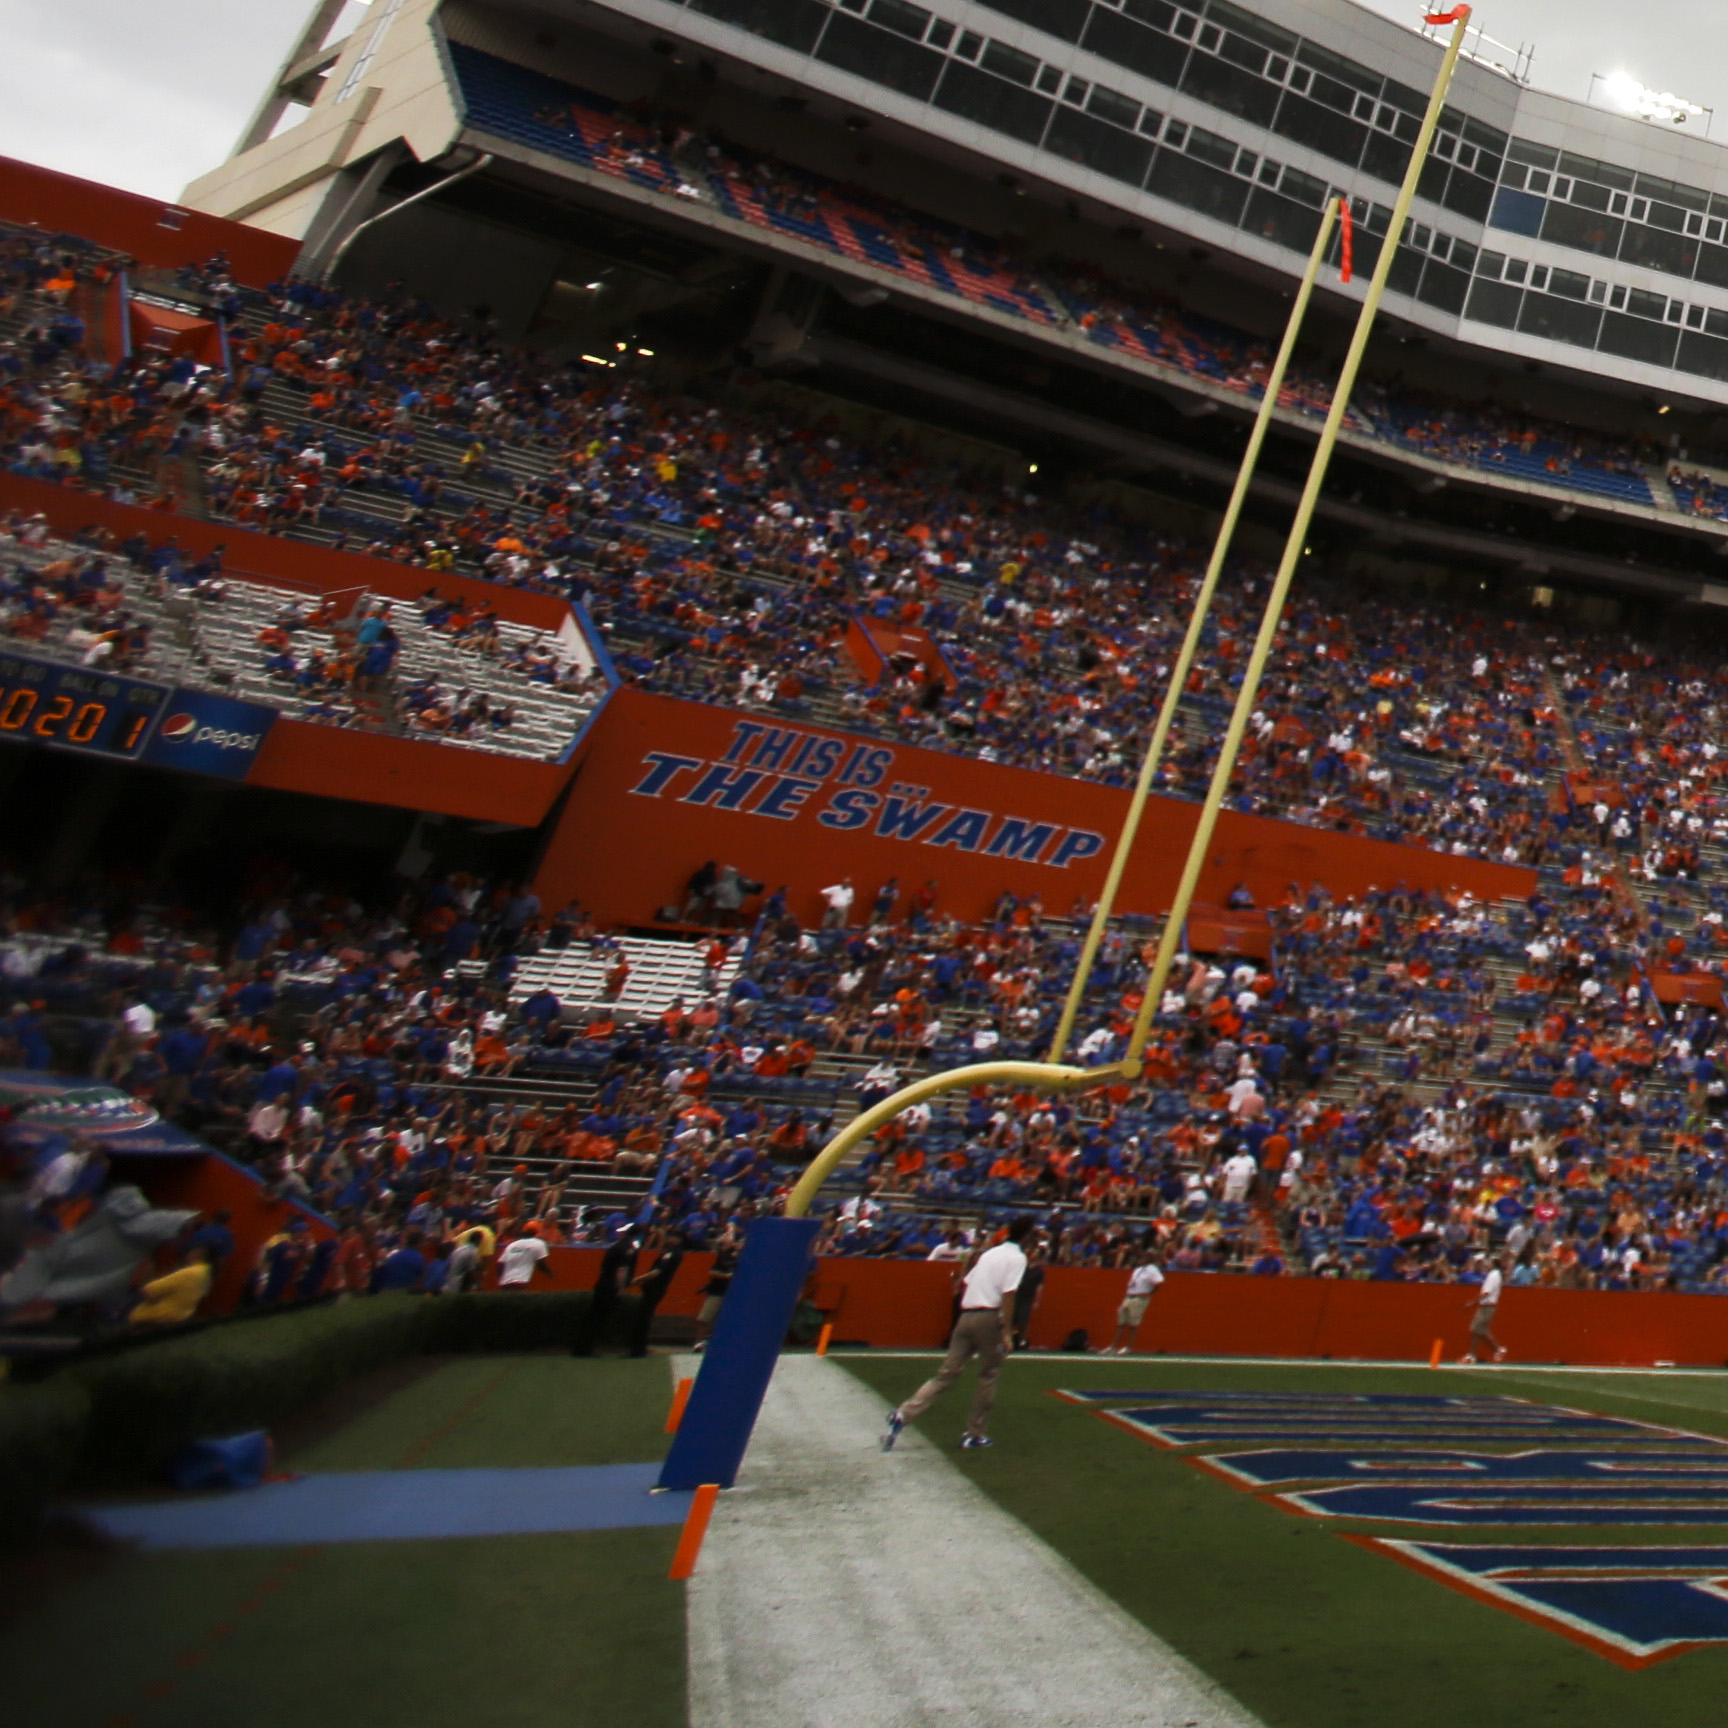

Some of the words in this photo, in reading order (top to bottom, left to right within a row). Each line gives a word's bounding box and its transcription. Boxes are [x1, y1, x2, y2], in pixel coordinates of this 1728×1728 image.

[193, 725, 261, 751] pepsi
[723, 720, 844, 781] THIS
[627, 751, 820, 821] THE
[817, 788, 1107, 869] SWAMP
